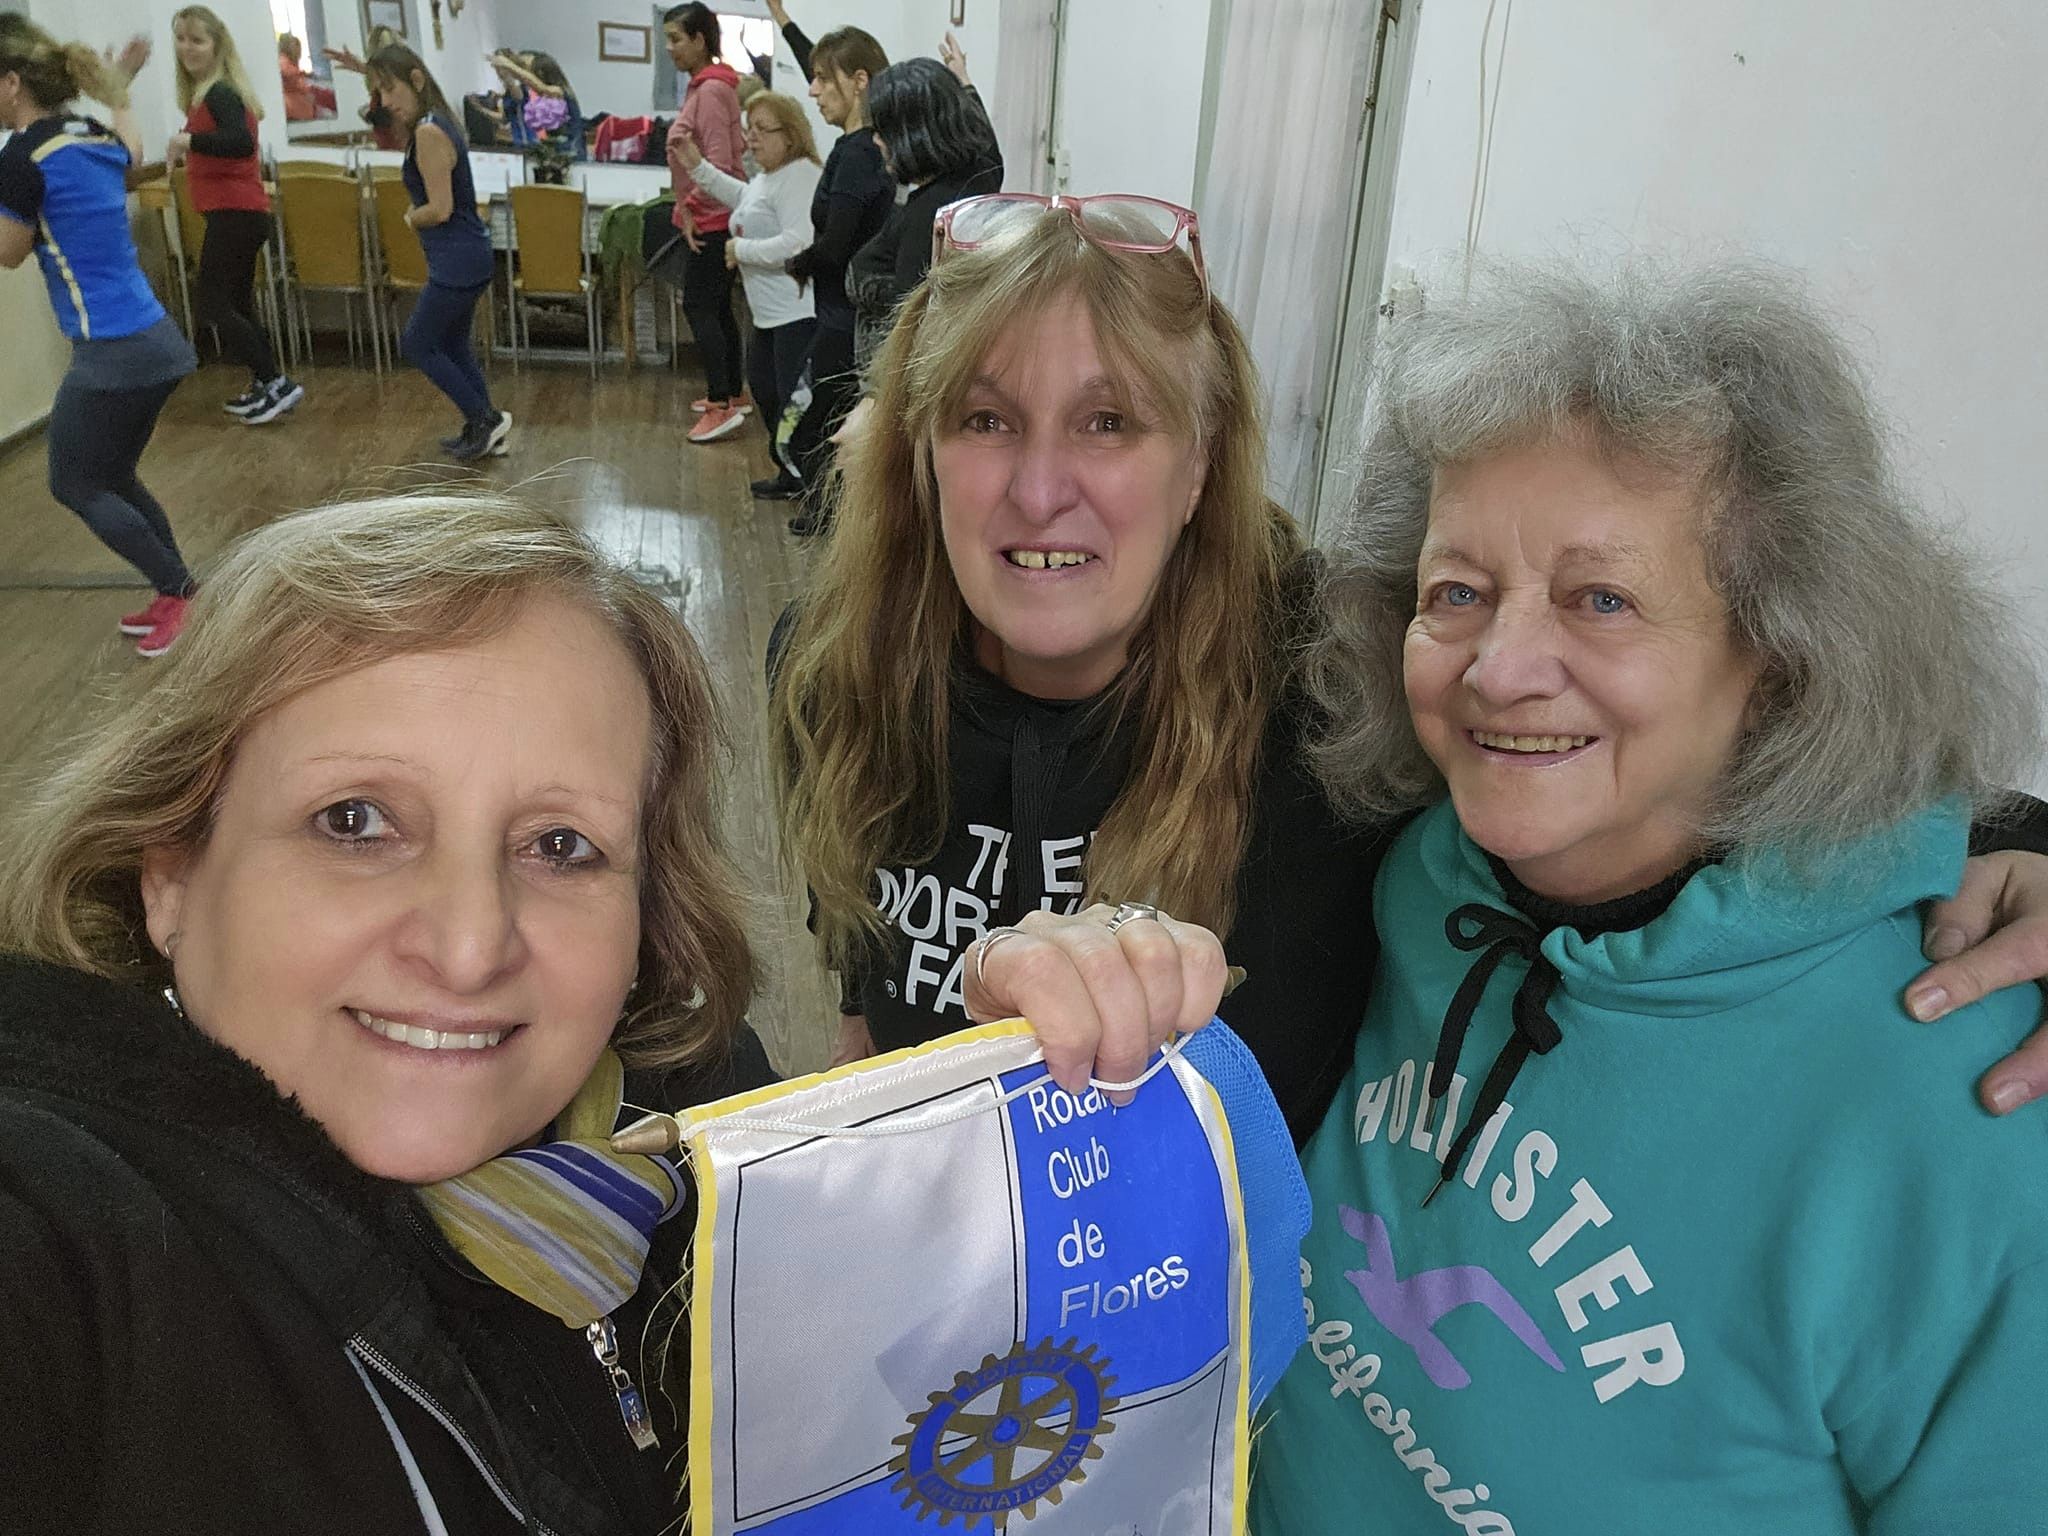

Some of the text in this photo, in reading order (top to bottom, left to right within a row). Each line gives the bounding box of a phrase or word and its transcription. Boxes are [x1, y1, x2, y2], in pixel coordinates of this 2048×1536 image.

[905, 940, 973, 1020] FA
[1028, 1085, 1117, 1133] Rota
[1048, 1136, 1110, 1199] Club
[1057, 1218, 1105, 1268] de
[1355, 1058, 1686, 1404] HOLLISTER
[1059, 1255, 1190, 1329] Flores
[920, 1442, 1087, 1511] INTERNATIONAL
